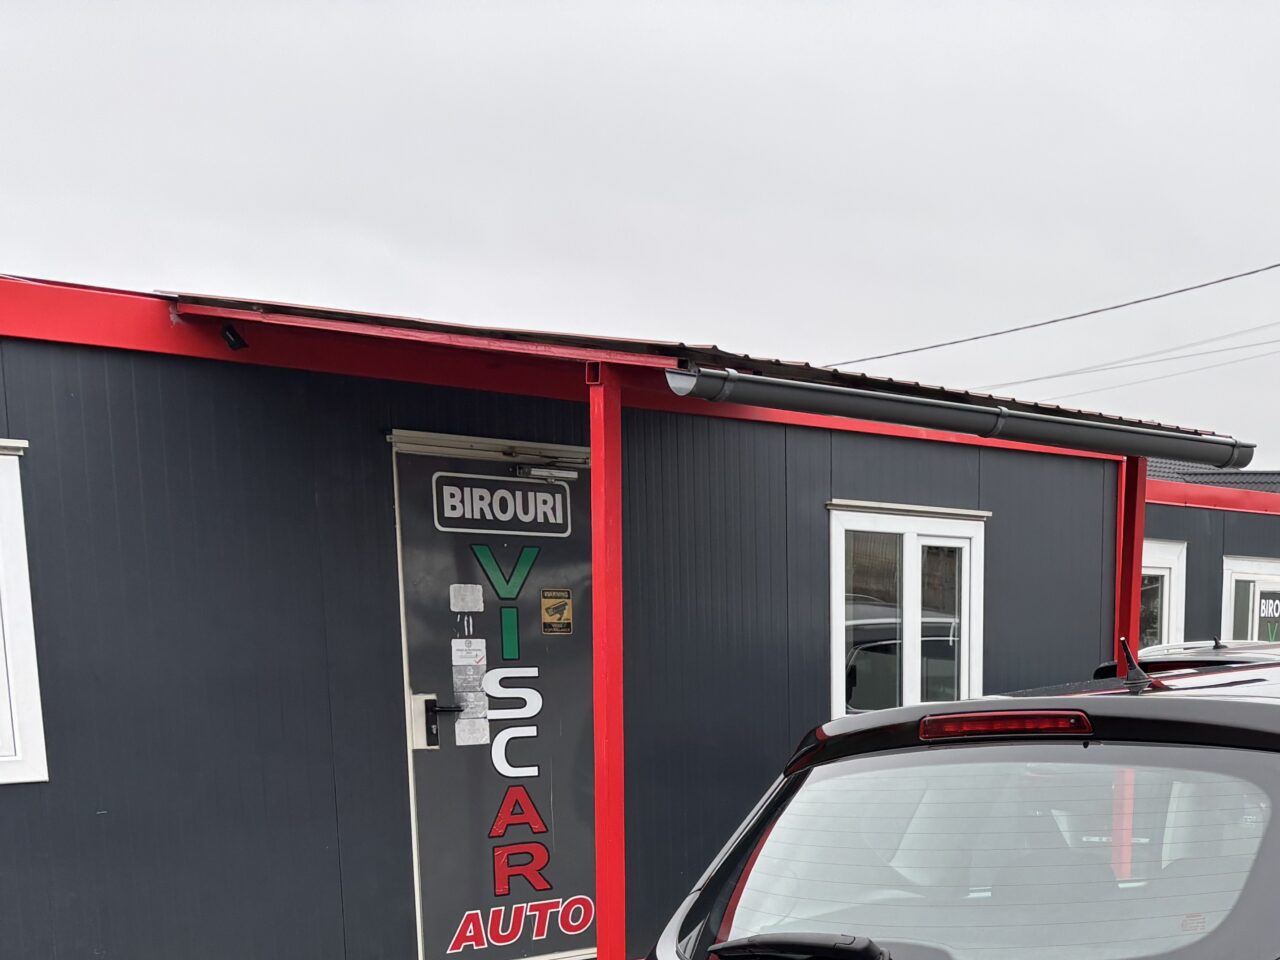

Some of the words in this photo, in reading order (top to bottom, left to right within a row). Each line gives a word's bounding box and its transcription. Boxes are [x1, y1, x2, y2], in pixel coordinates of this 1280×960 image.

[442, 485, 564, 524] BIROURI
[470, 544, 552, 896] VISCAR
[446, 895, 595, 954] AUTO
